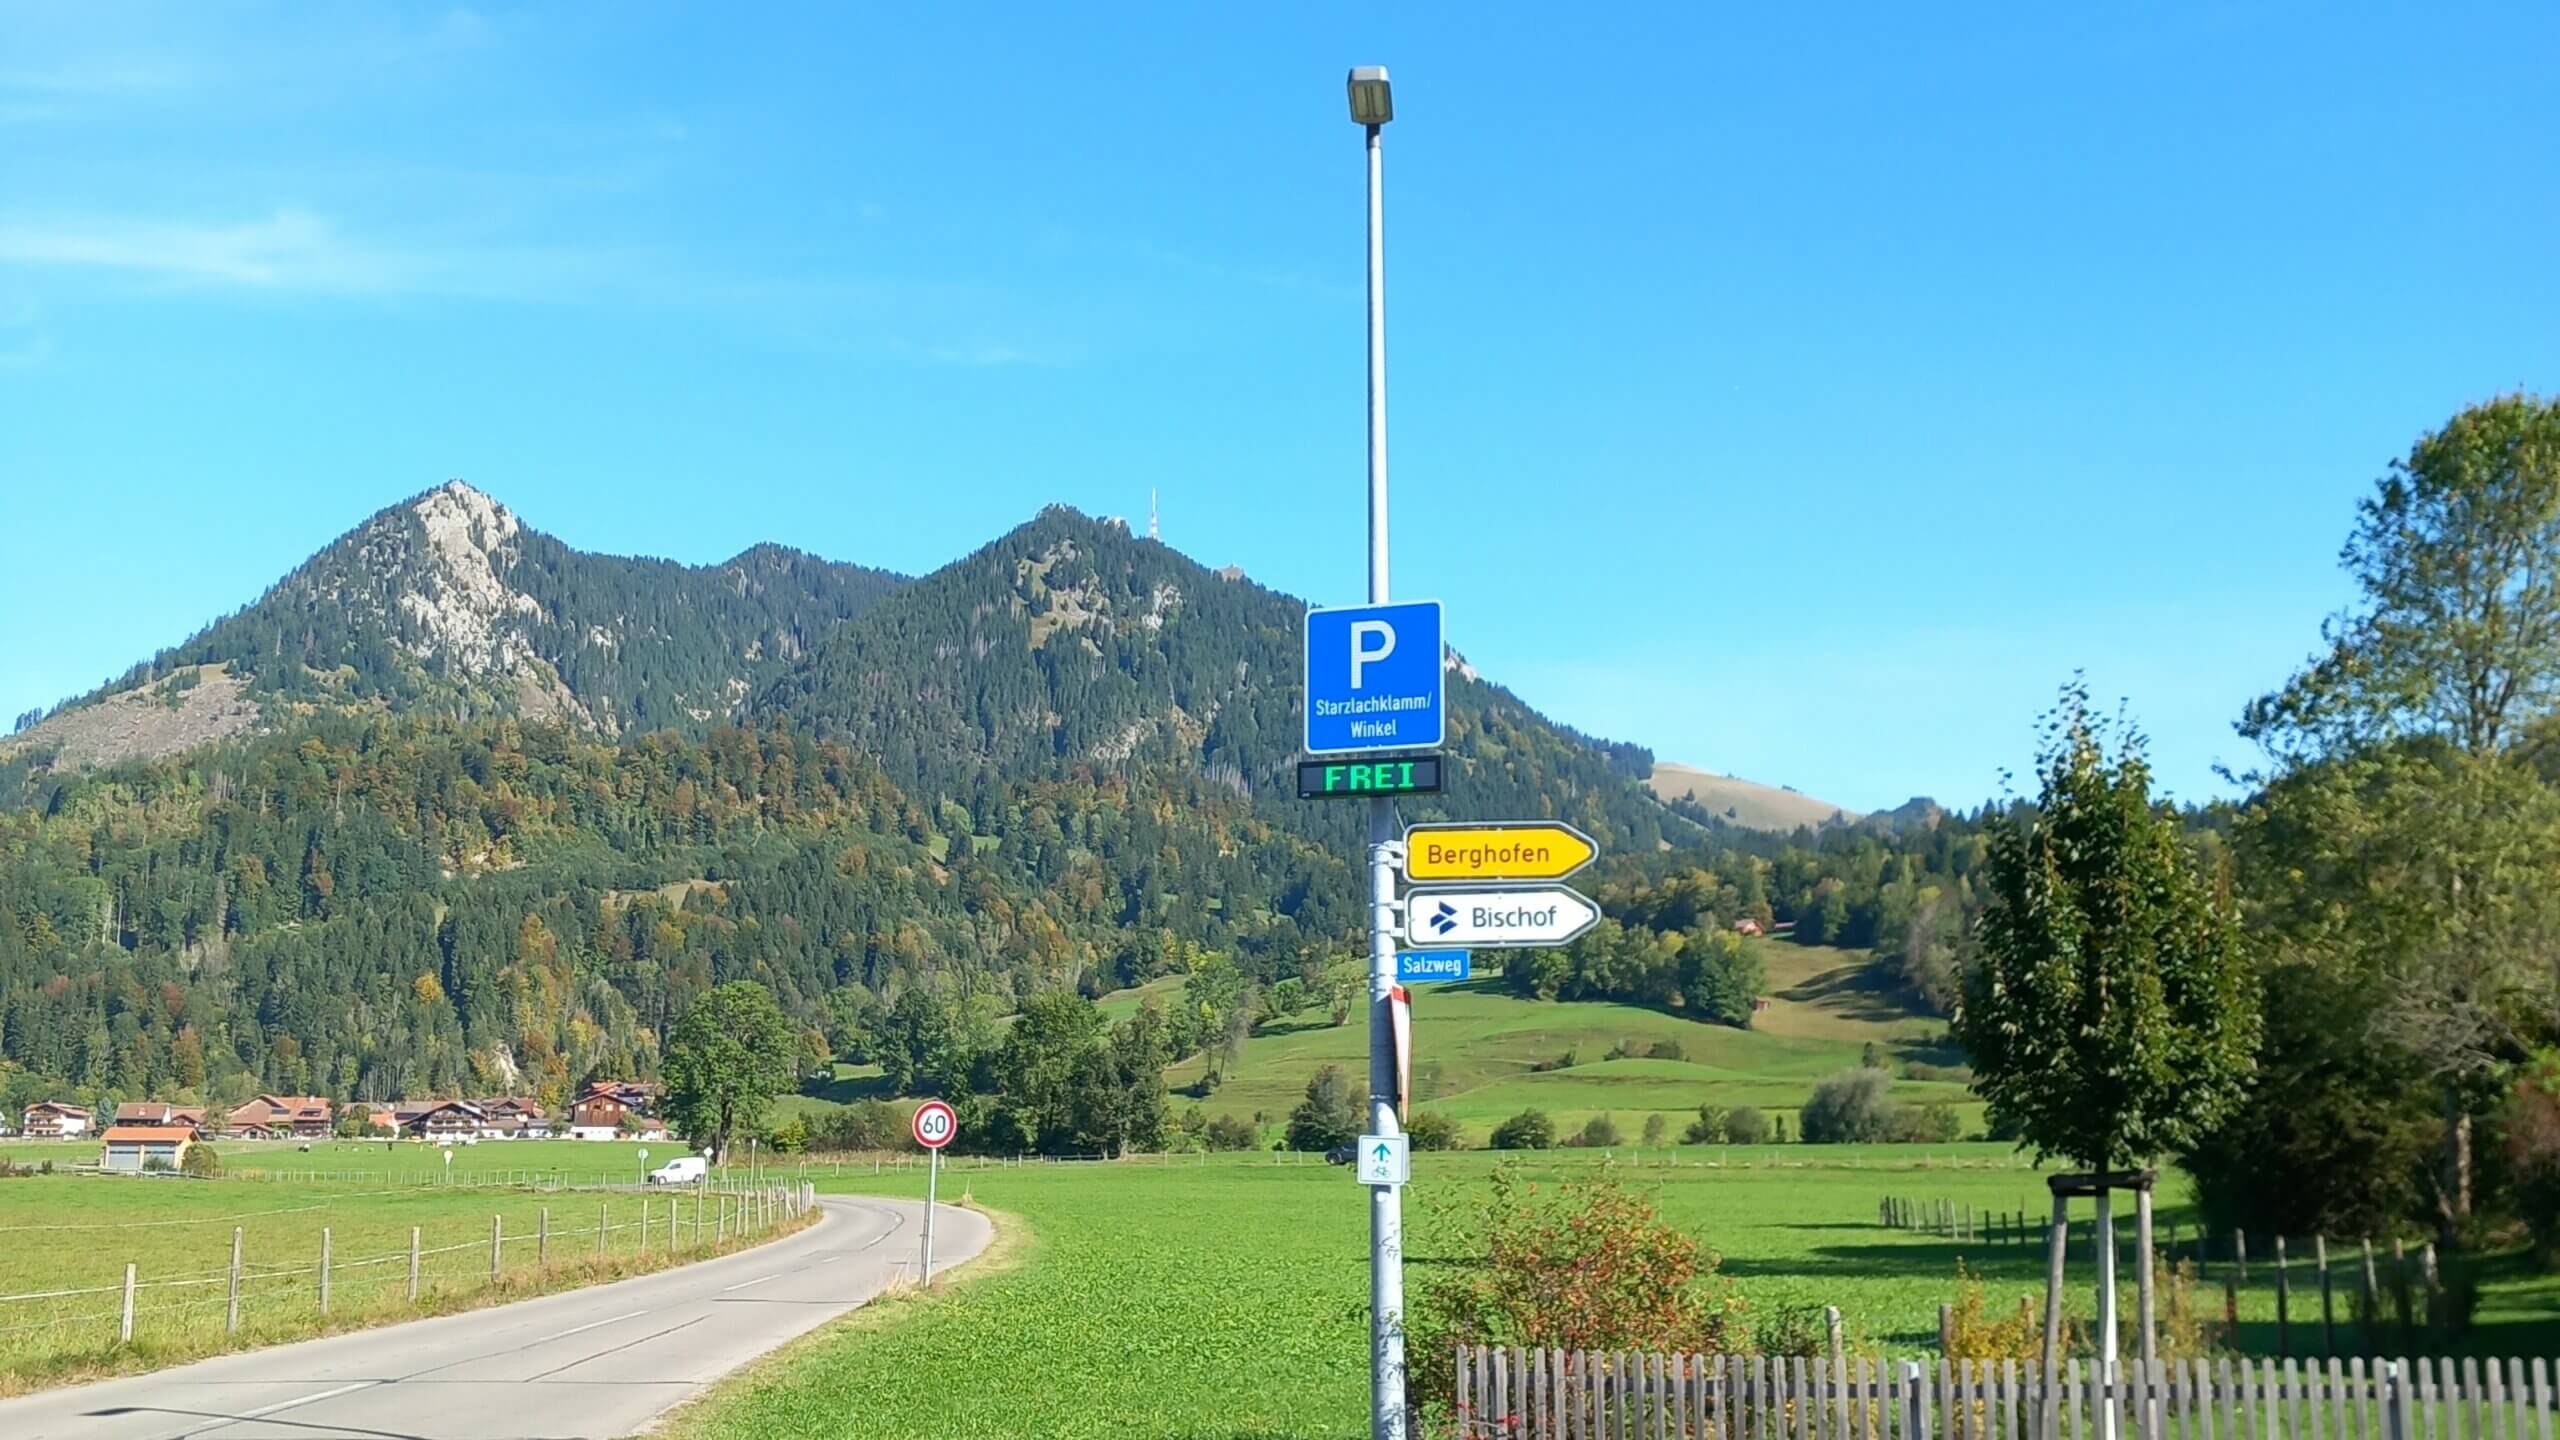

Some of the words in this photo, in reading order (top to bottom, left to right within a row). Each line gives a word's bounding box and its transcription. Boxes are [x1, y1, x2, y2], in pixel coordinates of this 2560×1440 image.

[1350, 619, 1397, 689] P
[1315, 690, 1432, 717] Starzlachklamm/
[1350, 718, 1397, 739] Winkel
[1324, 762, 1415, 792] FREI
[1427, 843, 1550, 868] Berghofen
[1472, 905, 1557, 928] Bischof
[1403, 956, 1462, 977] Salzweg
[922, 1114, 946, 1134] 60
